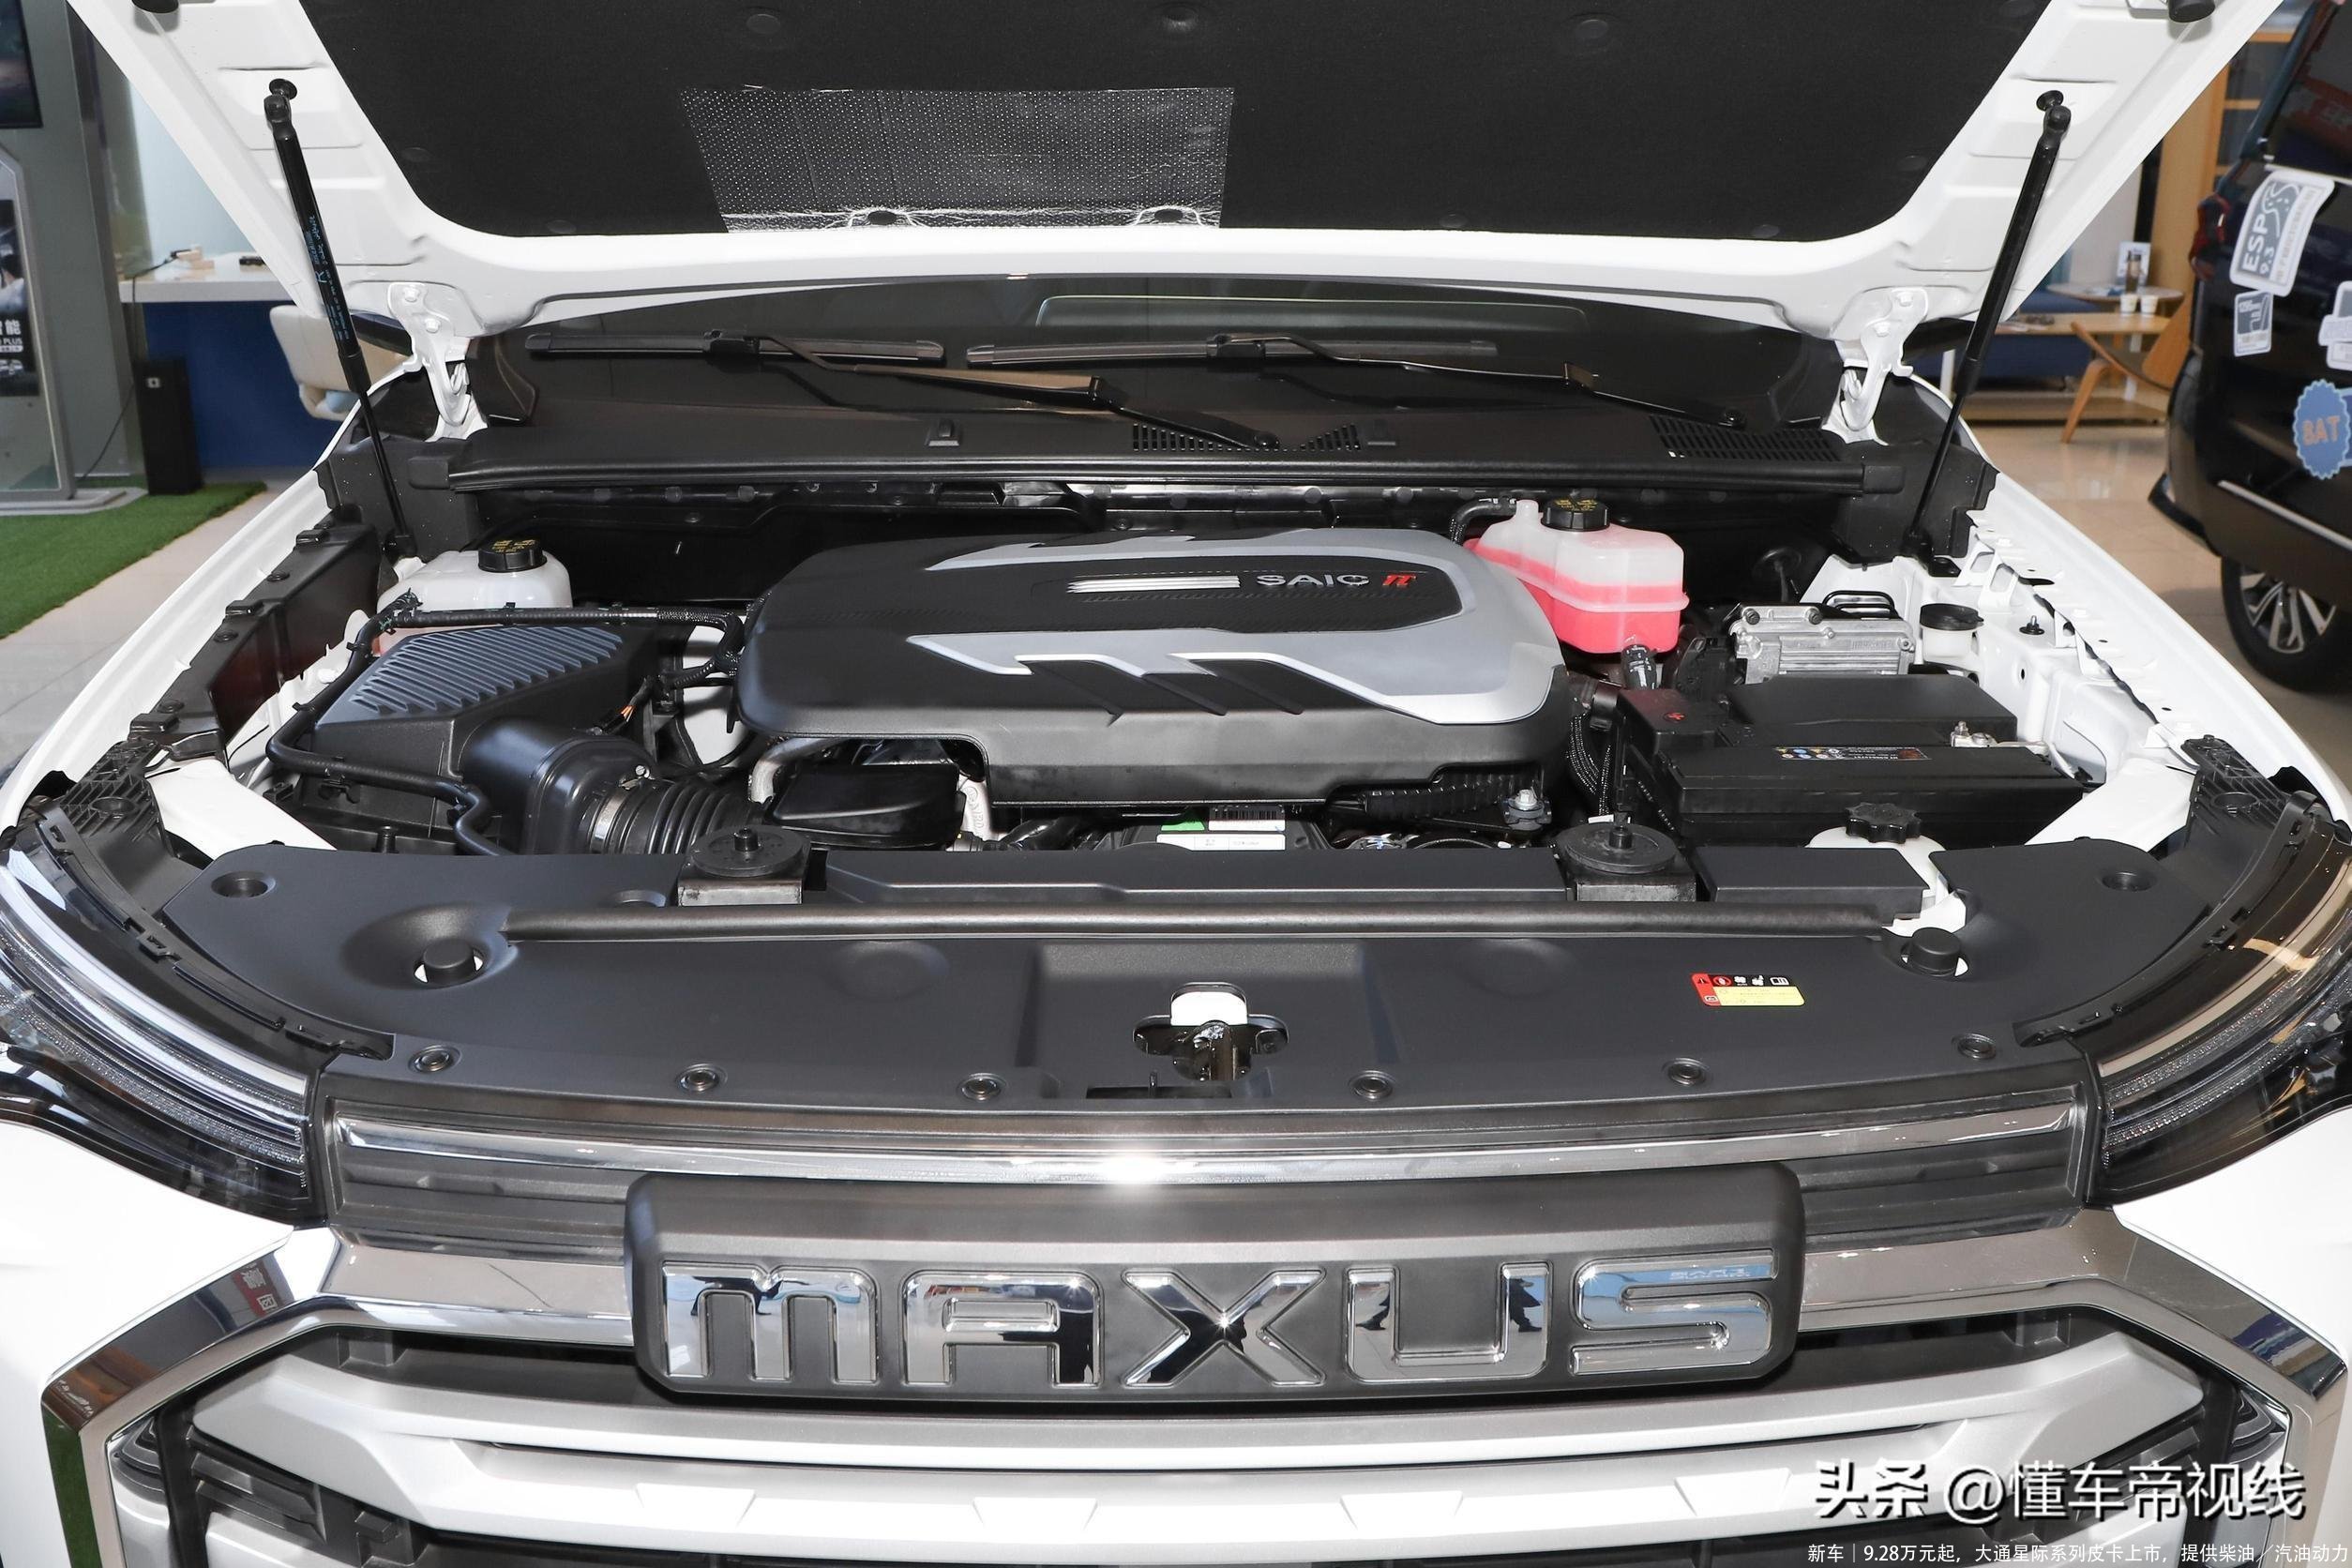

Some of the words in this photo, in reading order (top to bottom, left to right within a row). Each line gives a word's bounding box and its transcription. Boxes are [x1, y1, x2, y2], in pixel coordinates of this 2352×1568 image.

[2241, 214, 2269, 272] ESP
[1257, 574, 1370, 587] SAIC
[662, 1250, 1779, 1387] MAXUS
